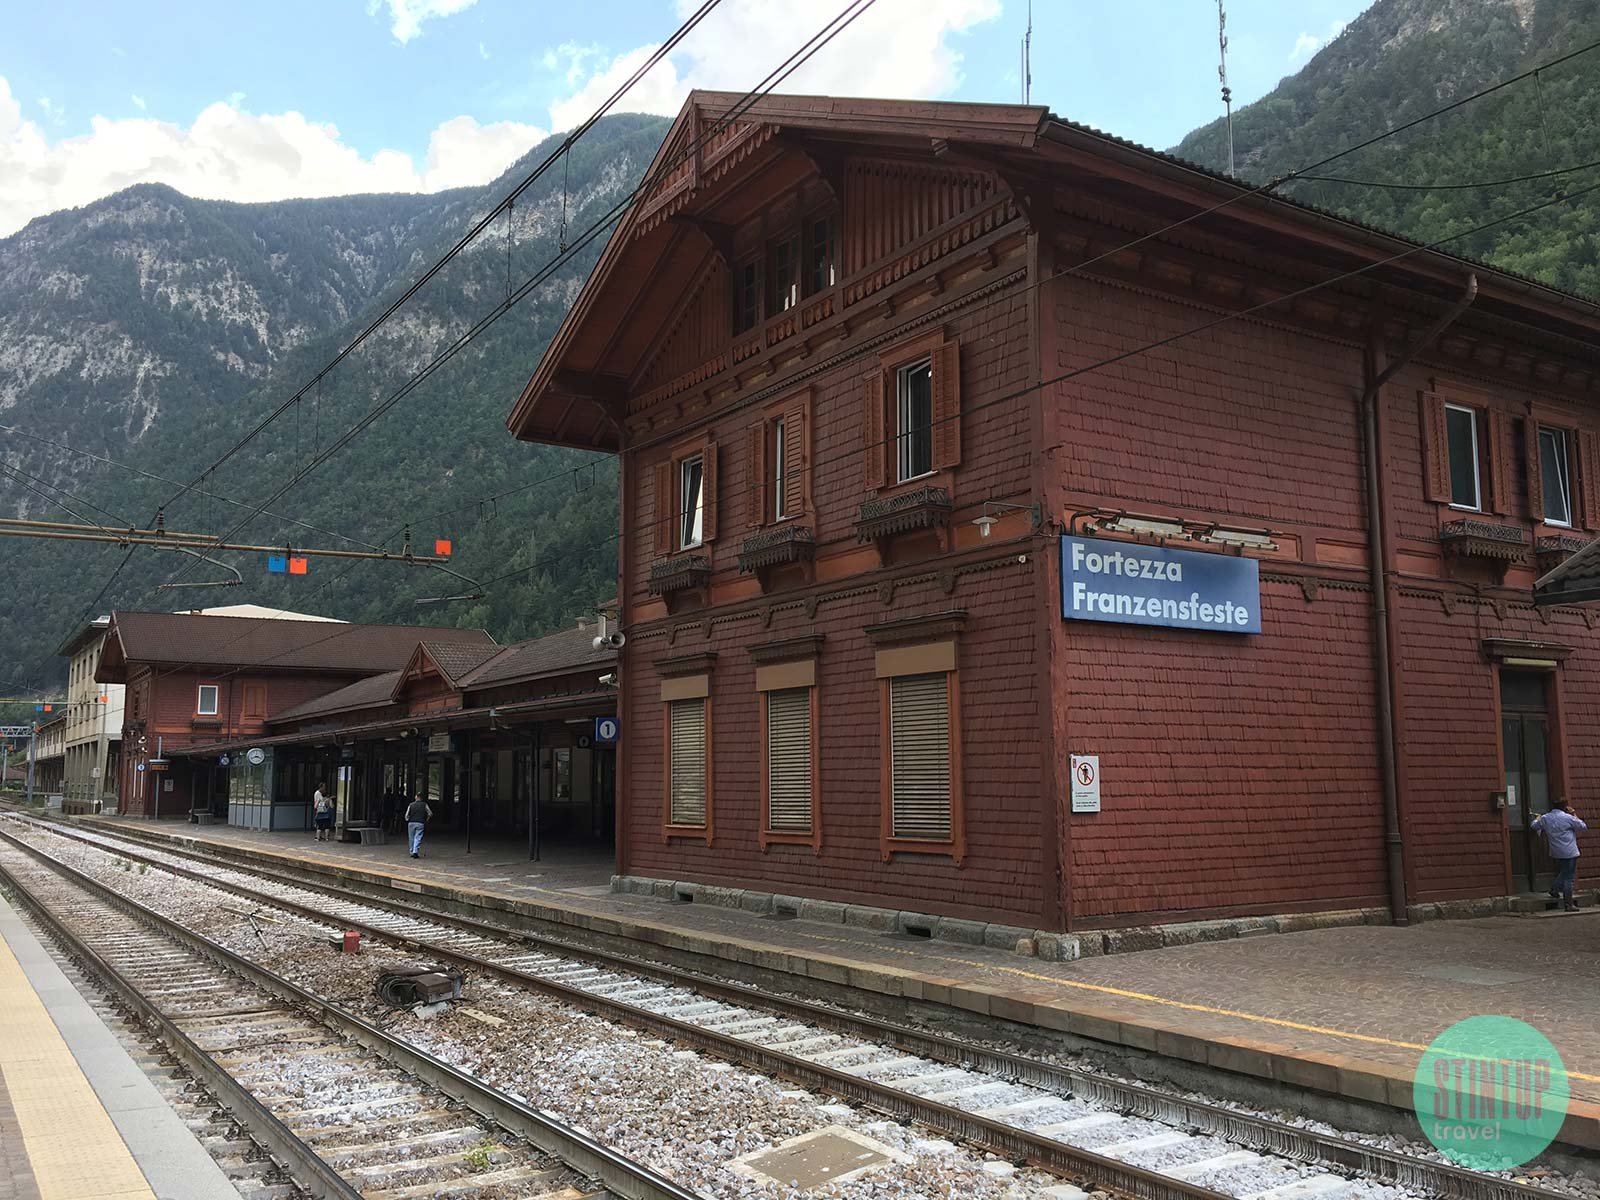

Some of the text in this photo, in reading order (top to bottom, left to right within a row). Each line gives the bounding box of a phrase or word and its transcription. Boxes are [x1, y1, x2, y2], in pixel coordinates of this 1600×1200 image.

[1071, 543, 1183, 582] Fortezza
[1072, 582, 1249, 625] Franzensfeste
[604, 723, 611, 736] 1
